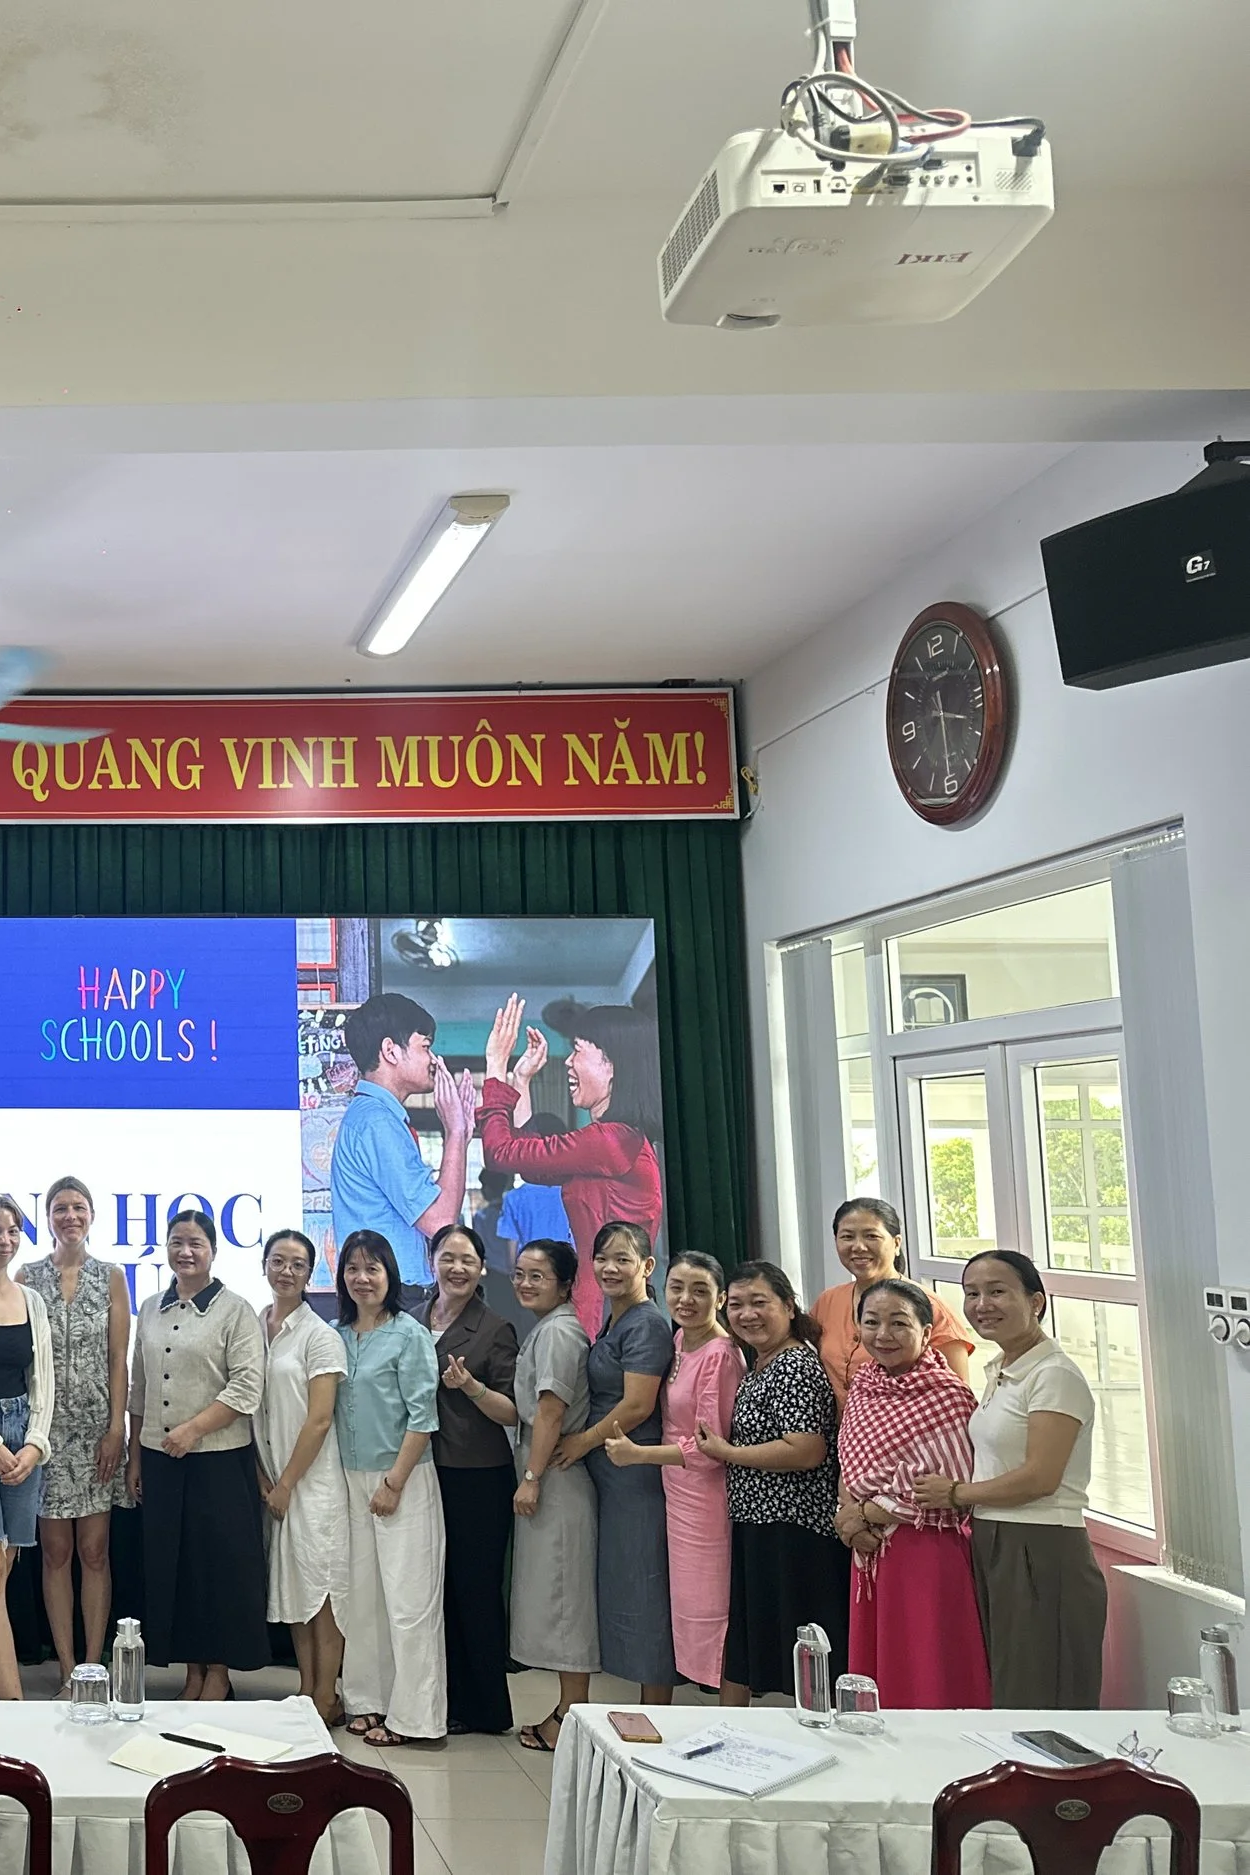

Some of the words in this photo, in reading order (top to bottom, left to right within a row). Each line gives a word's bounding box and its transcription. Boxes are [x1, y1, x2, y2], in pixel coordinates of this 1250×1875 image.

[1186, 556, 1210, 574] G7
[926, 634, 944, 659] 12
[902, 721, 916, 743] 9
[12, 736, 205, 802] QUANG
[220, 736, 358, 790] VINH
[376, 719, 546, 788] MUÔN
[563, 719, 708, 786] NĂM!
[944, 773, 958, 795] 6
[78, 965, 186, 1011] HAPPY
[40, 1016, 195, 1062] SCHOOLS
